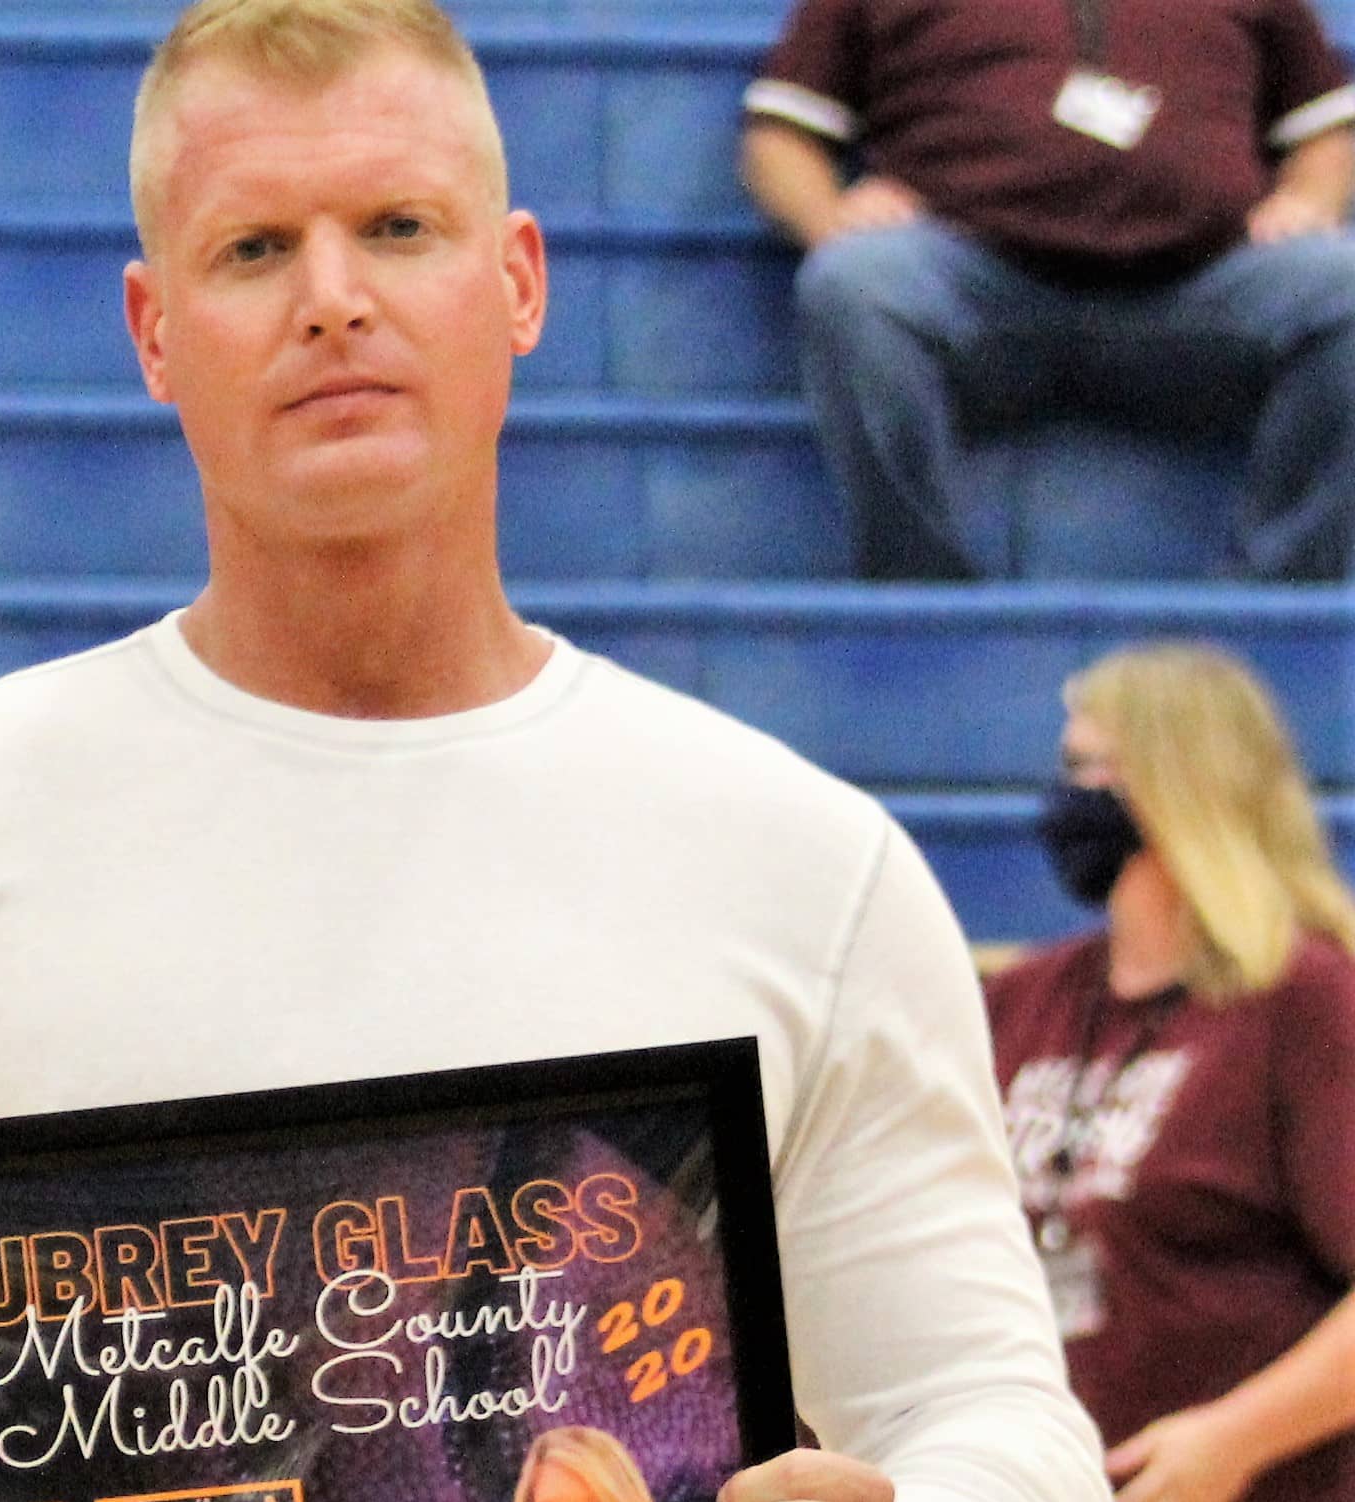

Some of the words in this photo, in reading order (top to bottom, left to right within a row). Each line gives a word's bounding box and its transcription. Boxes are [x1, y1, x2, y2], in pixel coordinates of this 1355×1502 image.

[313, 1174, 641, 1288] GLASS
[314, 1265, 588, 1373] County
[597, 1277, 684, 1347] 20
[311, 1337, 569, 1435] School
[624, 1326, 713, 1402] 20
